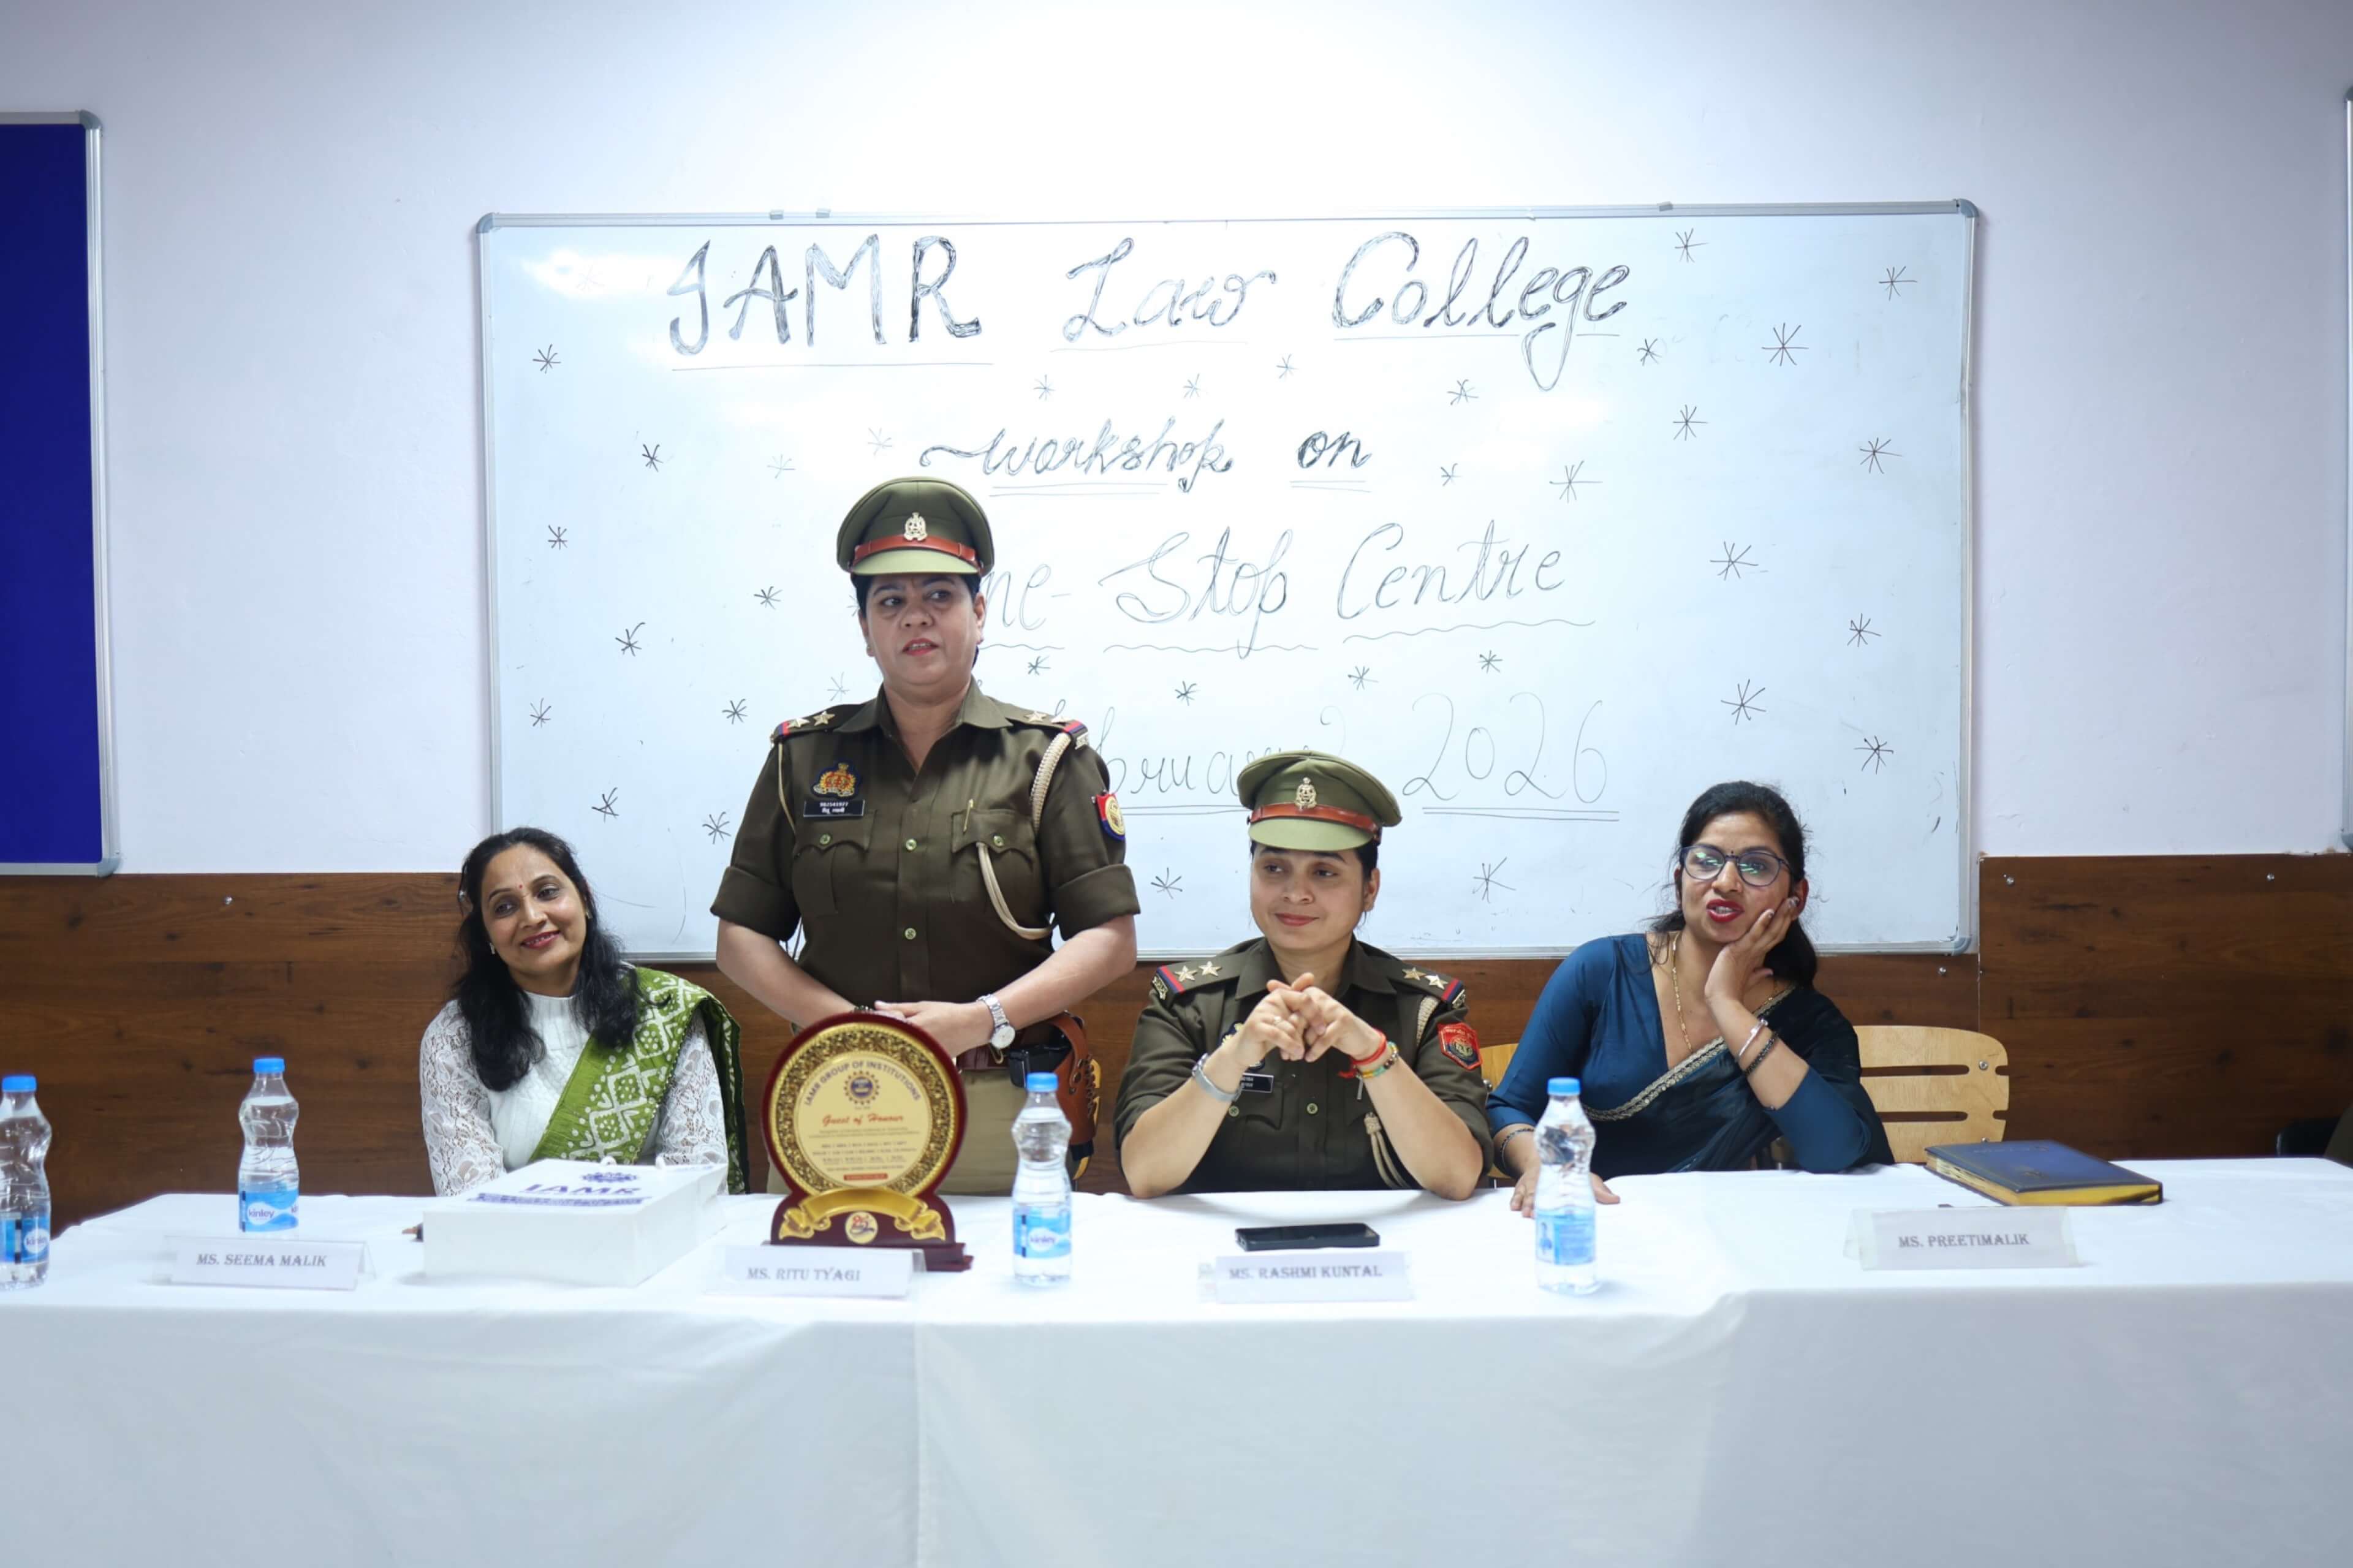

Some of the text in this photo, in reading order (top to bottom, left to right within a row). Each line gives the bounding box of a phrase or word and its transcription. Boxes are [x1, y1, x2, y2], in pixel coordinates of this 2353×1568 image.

[1063, 237, 1277, 342] Law
[1332, 231, 1631, 391] College
[1295, 430, 1372, 470] on
[1098, 526, 1294, 659] Stop
[1336, 520, 1566, 619] Centre
[1402, 691, 1607, 804] 2026
[820, 1062, 850, 1084] GROUP
[866, 1061, 921, 1100] INSTITUTIONS
[822, 1114, 850, 1126] Guest
[854, 1115, 863, 1126] of
[249, 1209, 275, 1218] kinley
[1898, 1236, 1923, 1248] MS.
[196, 1254, 327, 1267] MS. SEEMA MALIK
[747, 1268, 860, 1282] MS. RITU TYAGI
[1259, 1267, 1317, 1279] RASHMI
[1322, 1265, 1383, 1278] KUNTAL
